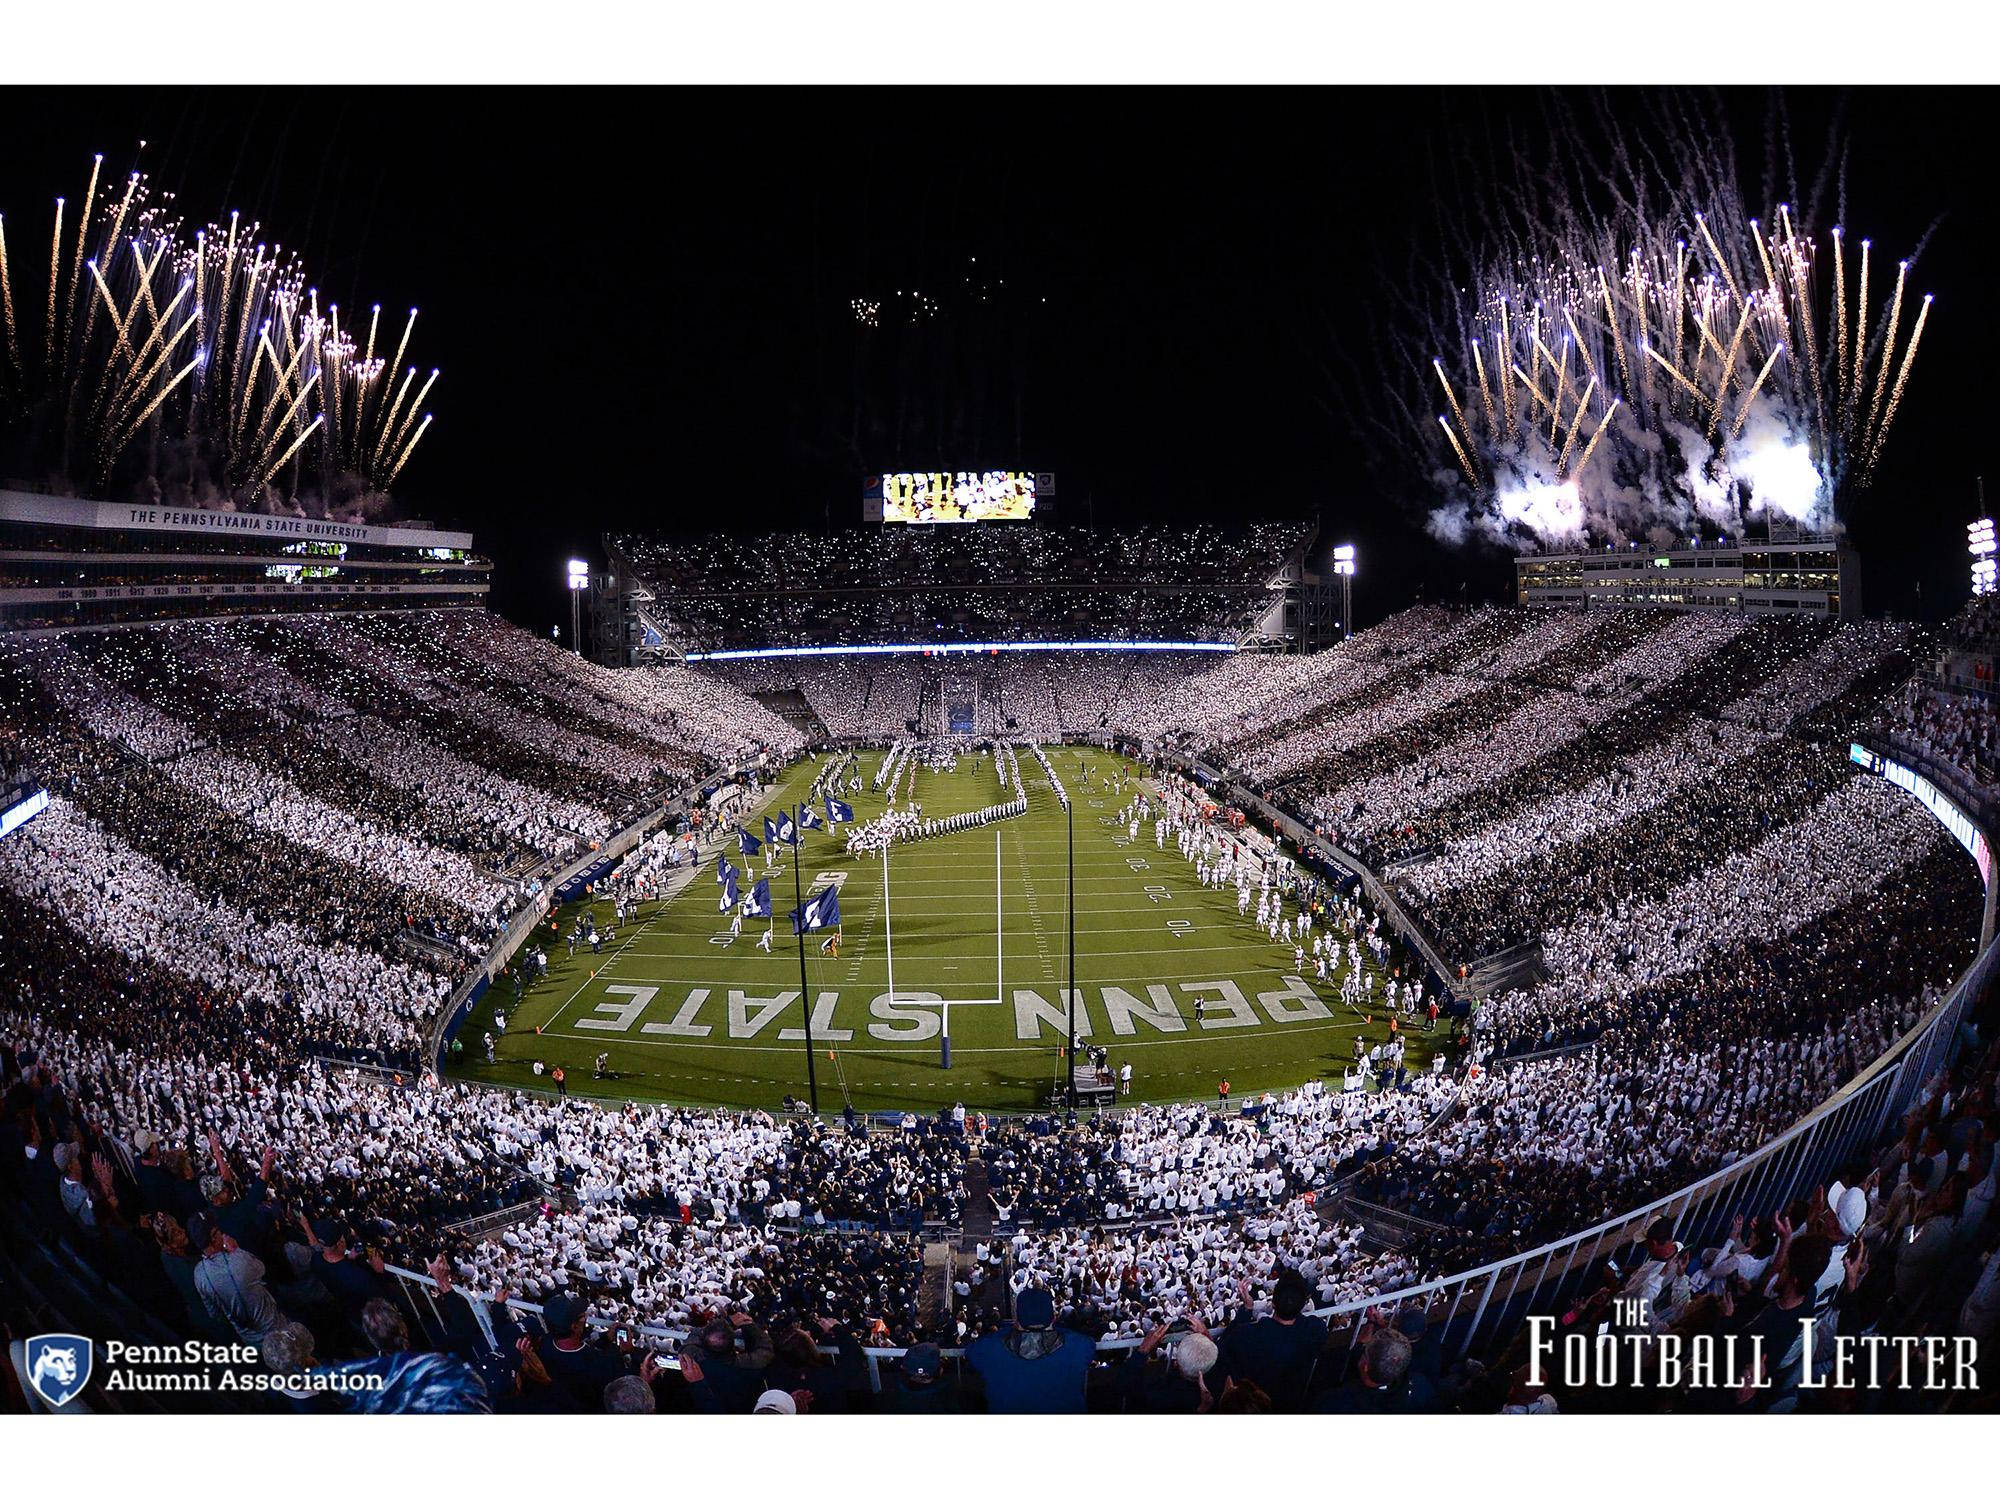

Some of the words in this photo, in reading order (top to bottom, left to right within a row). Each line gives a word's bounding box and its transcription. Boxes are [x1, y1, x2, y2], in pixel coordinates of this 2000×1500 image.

[130, 510, 157, 523] THE
[163, 512, 261, 530] PENNSYLVANIA
[266, 517, 301, 533] STATE
[306, 522, 369, 539] UNIVERSITY
[1143, 885, 1173, 903] 20
[1166, 919, 1197, 937] 10
[573, 984, 943, 1042] STATE
[1012, 975, 1334, 1040] PENN
